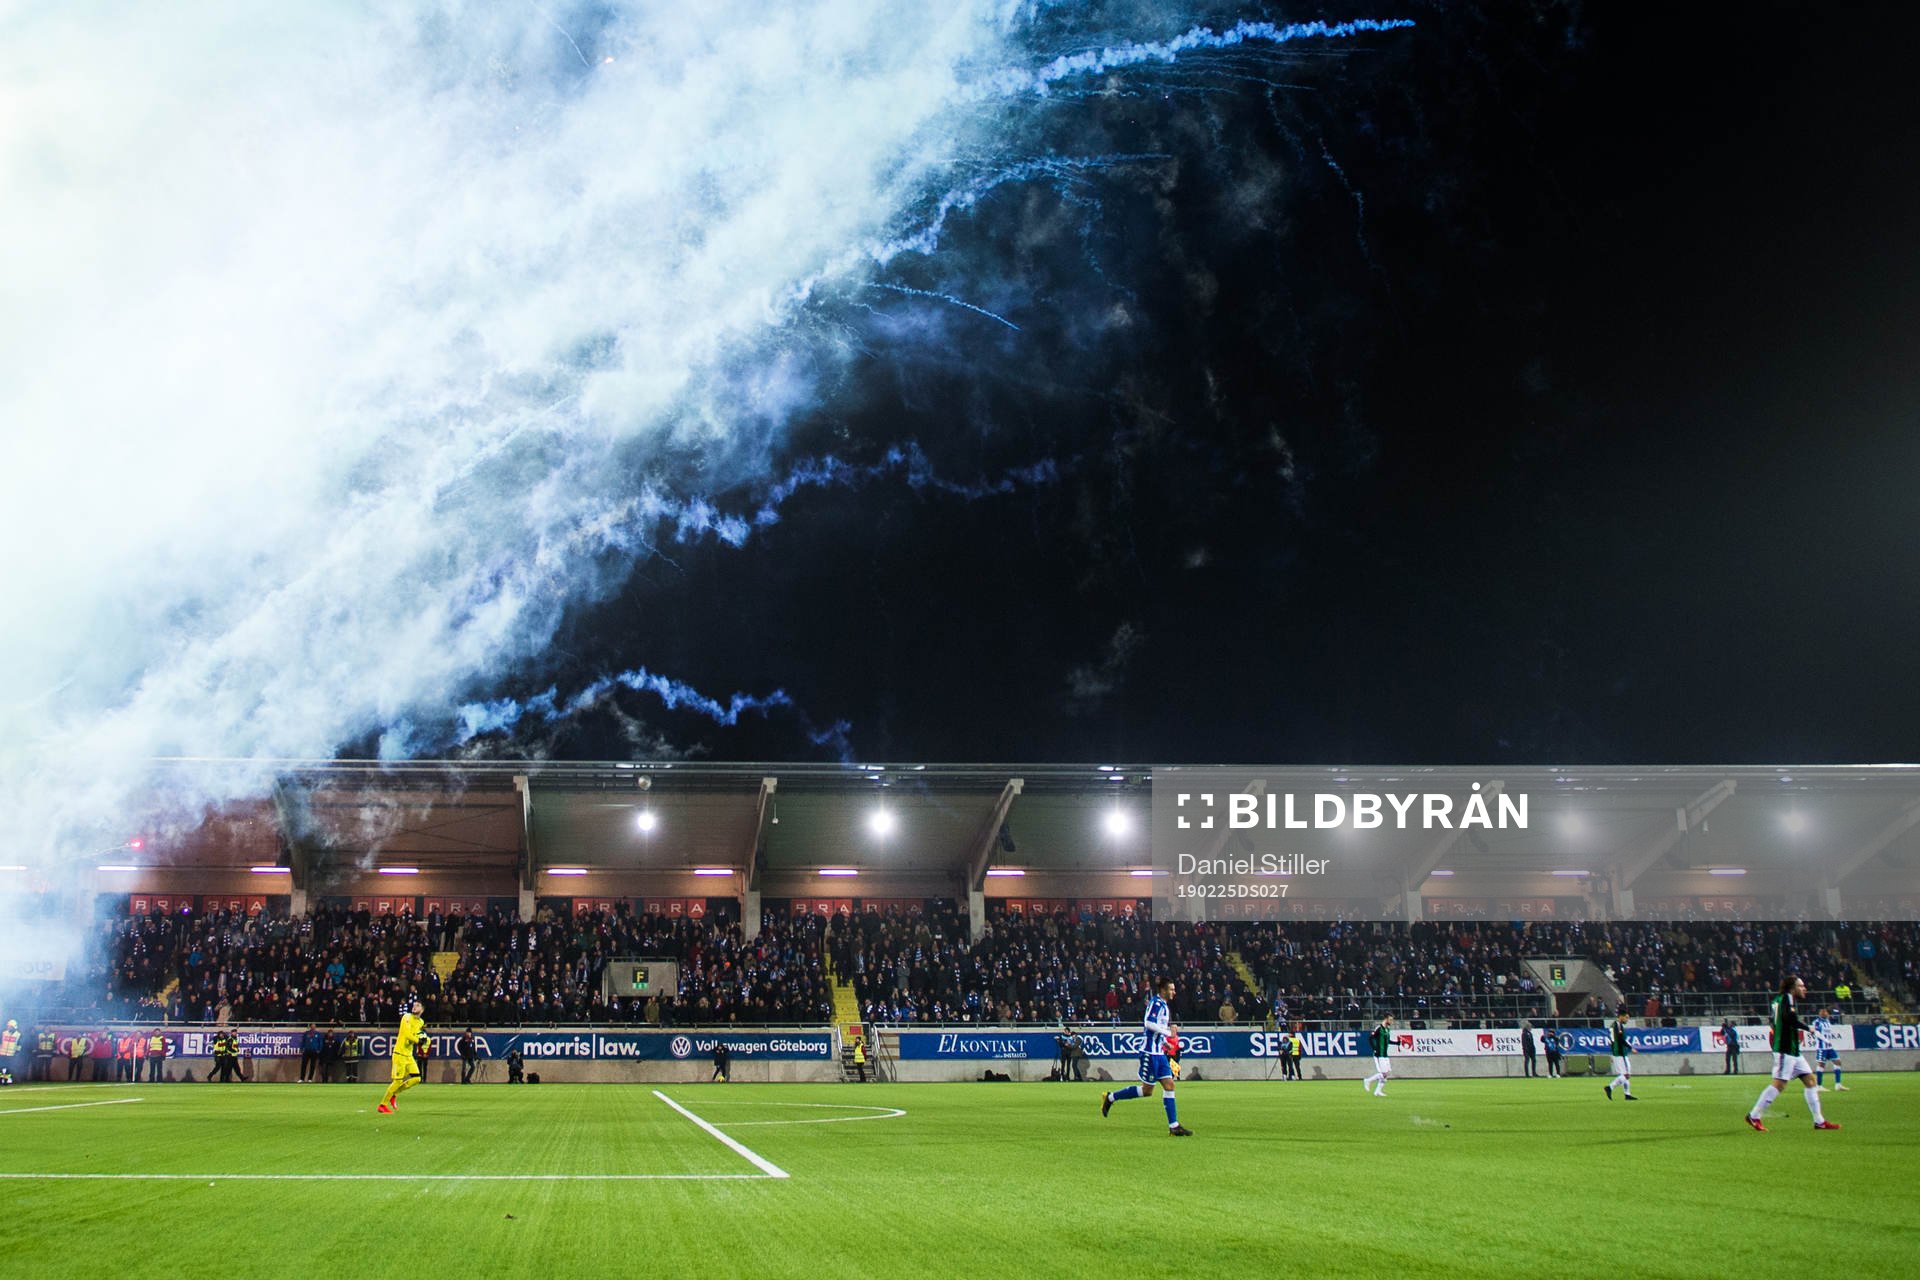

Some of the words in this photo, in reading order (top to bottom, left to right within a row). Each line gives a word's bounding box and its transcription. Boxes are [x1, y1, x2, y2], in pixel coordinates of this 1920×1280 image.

[636, 971, 644, 982] F
[1416, 1037, 1453, 1045] SVENSKA
[1495, 1036, 1521, 1044] SVENS
[1643, 1035, 1689, 1046] CUPEN
[1875, 1024, 1920, 1049] SER
[523, 1036, 591, 1056] morris
[769, 1039, 828, 1055] Göteborg
[959, 1040, 1027, 1053] KONTAKT
[1111, 1033, 1212, 1056] Kapa
